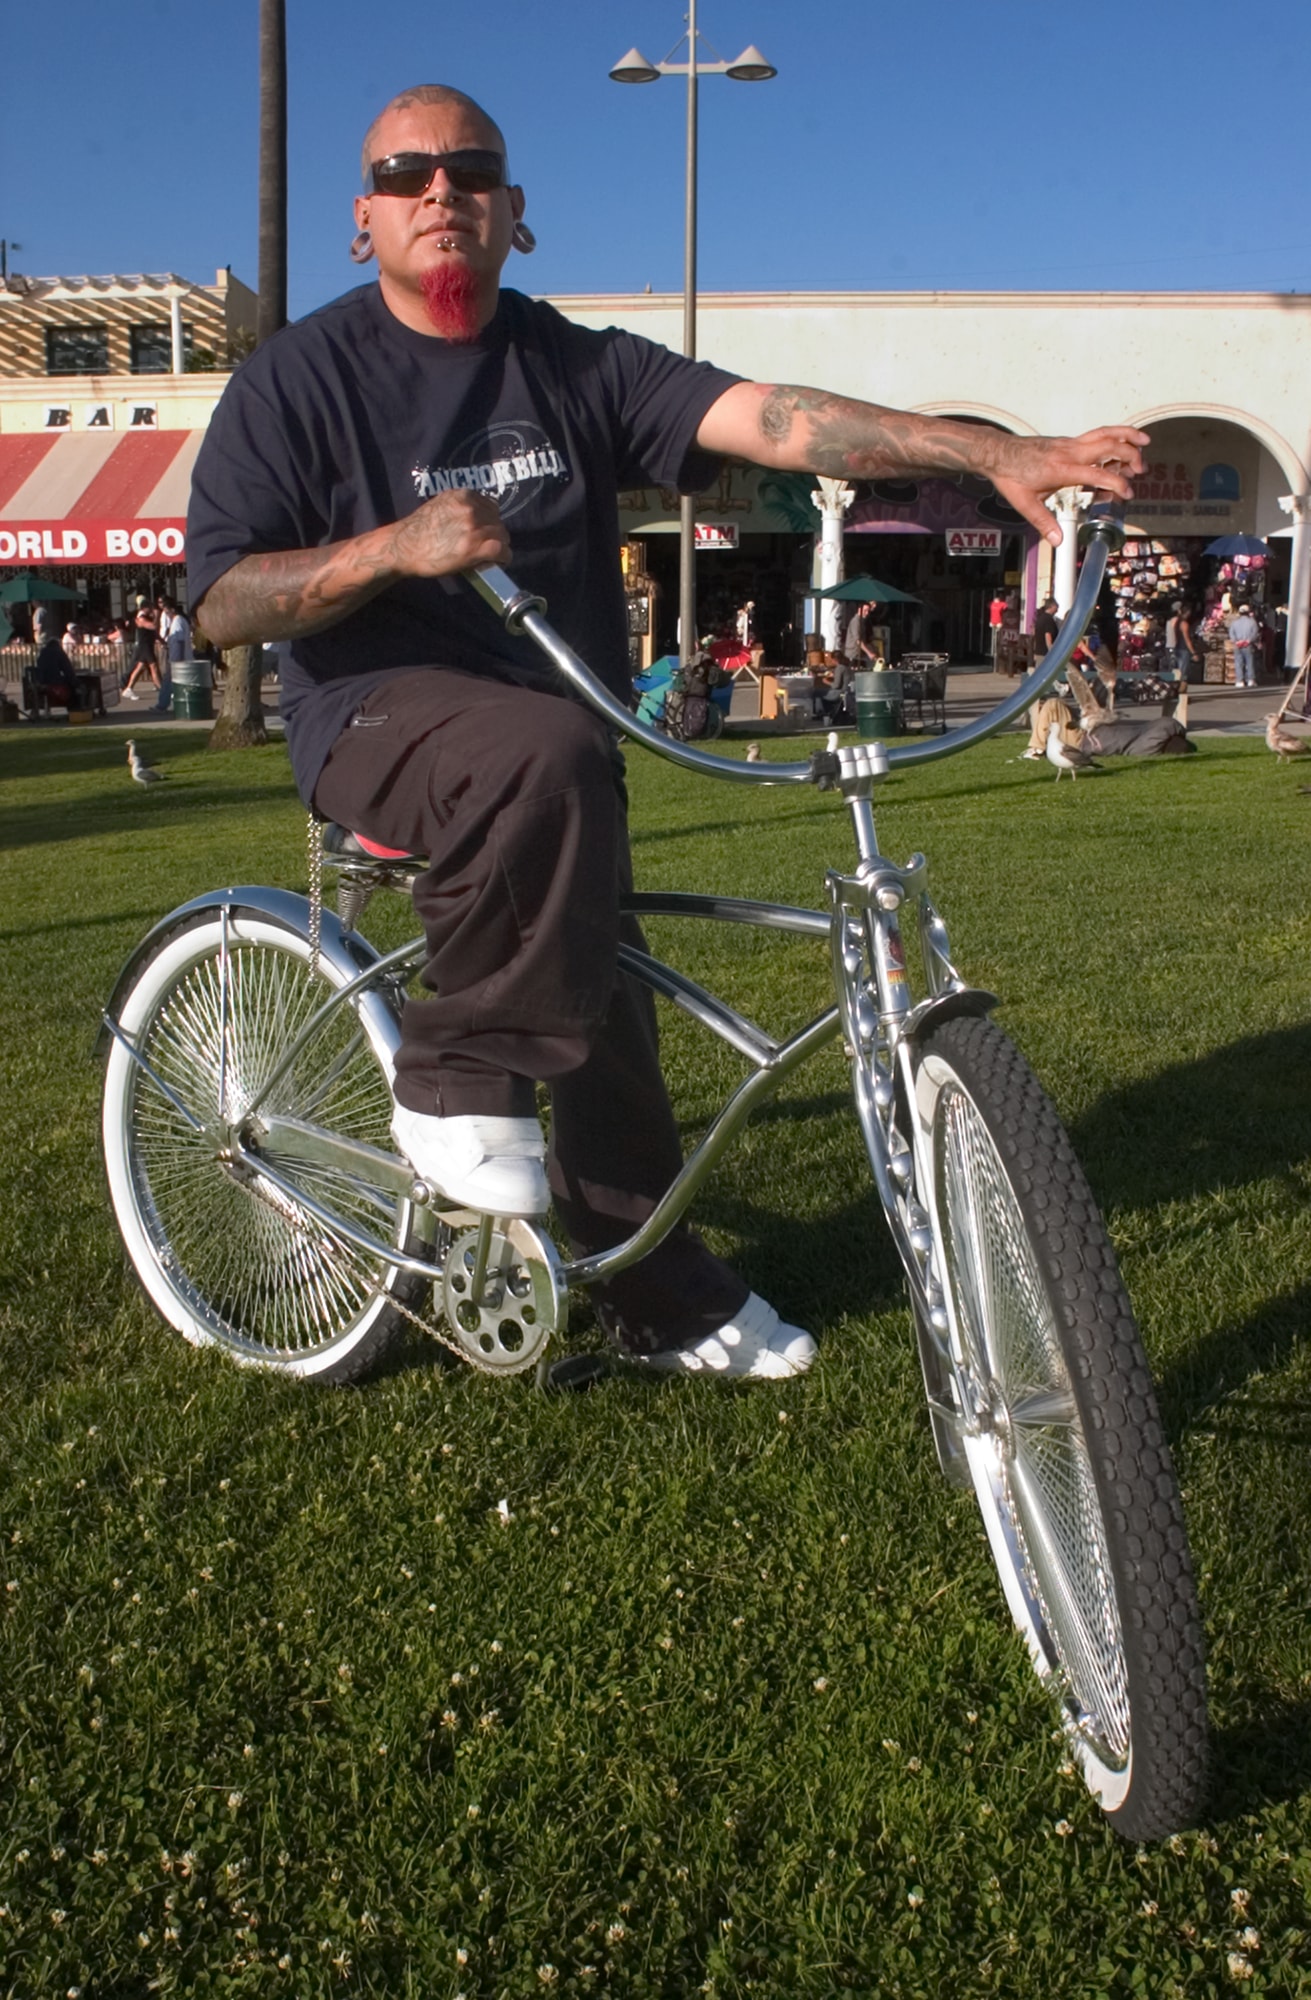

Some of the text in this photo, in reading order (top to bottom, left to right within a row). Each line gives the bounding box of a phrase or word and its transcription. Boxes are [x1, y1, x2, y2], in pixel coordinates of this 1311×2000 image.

[45, 407, 157, 427] BAR
[694, 526, 735, 540] ATM
[949, 532, 997, 547] ATM
